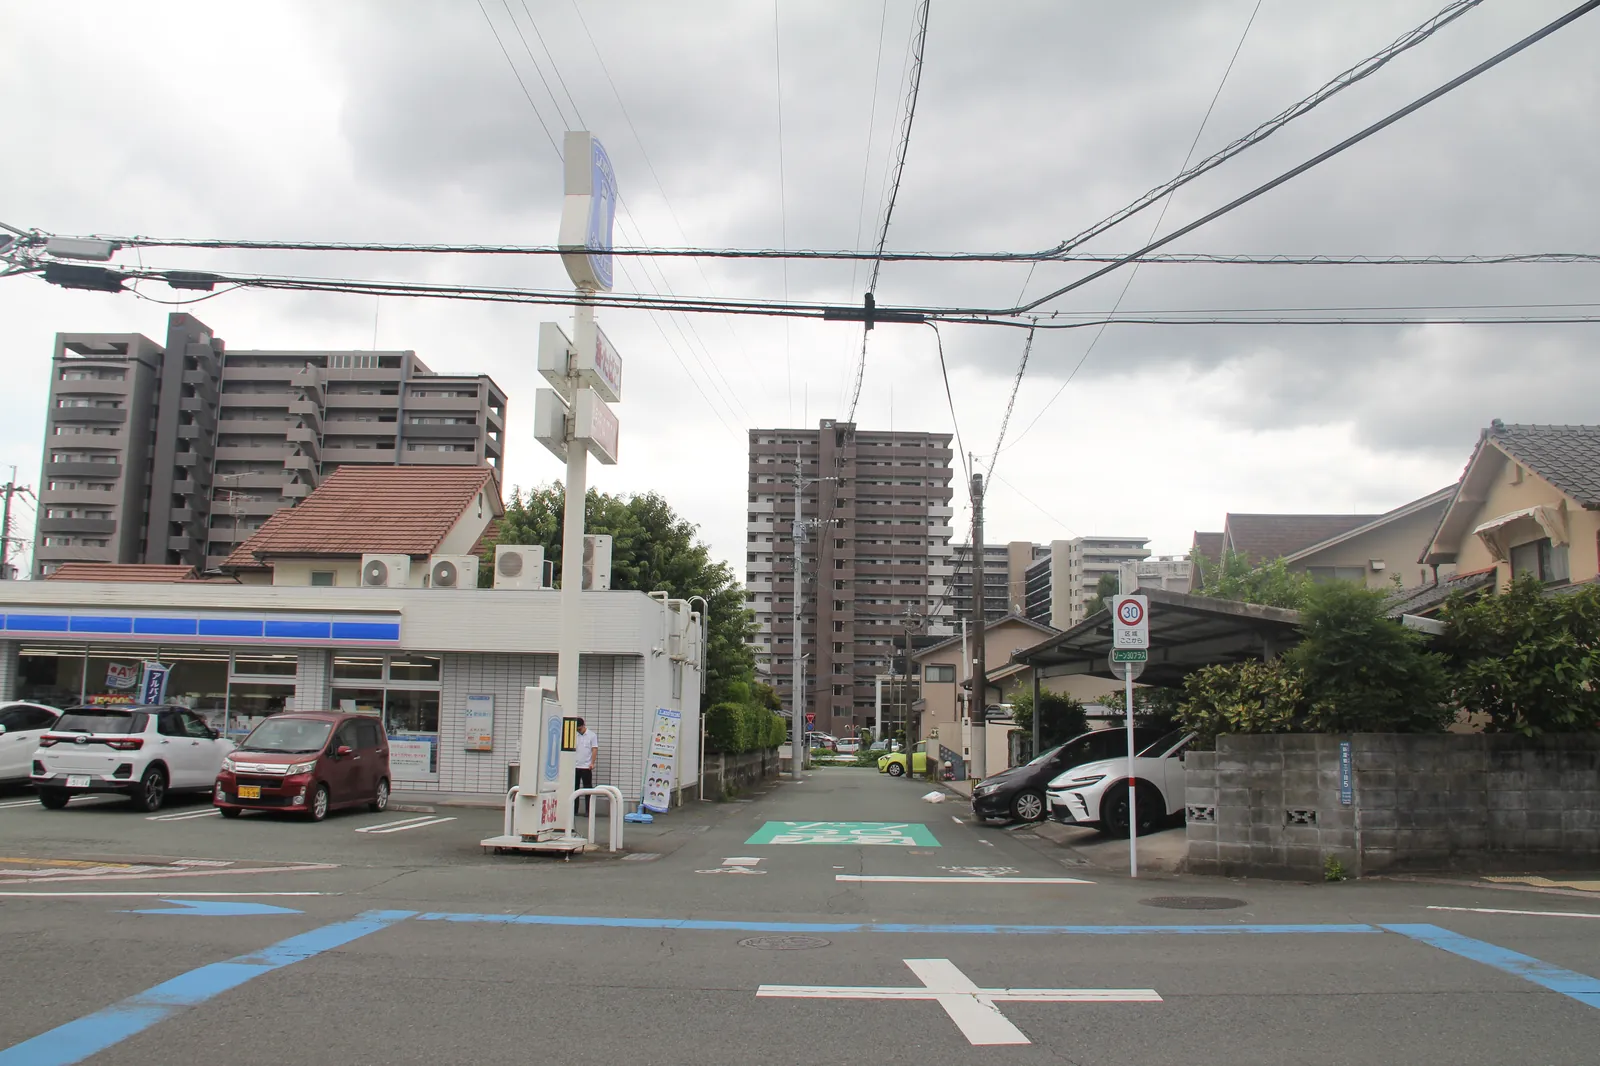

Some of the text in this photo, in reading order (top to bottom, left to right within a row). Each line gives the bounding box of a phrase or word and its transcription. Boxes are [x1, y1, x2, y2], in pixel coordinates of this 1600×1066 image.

[1123, 606, 1138, 619] 30
[1114, 651, 1146, 660] ゾーン30プラス
[148, 672, 162, 705] アルバイ
